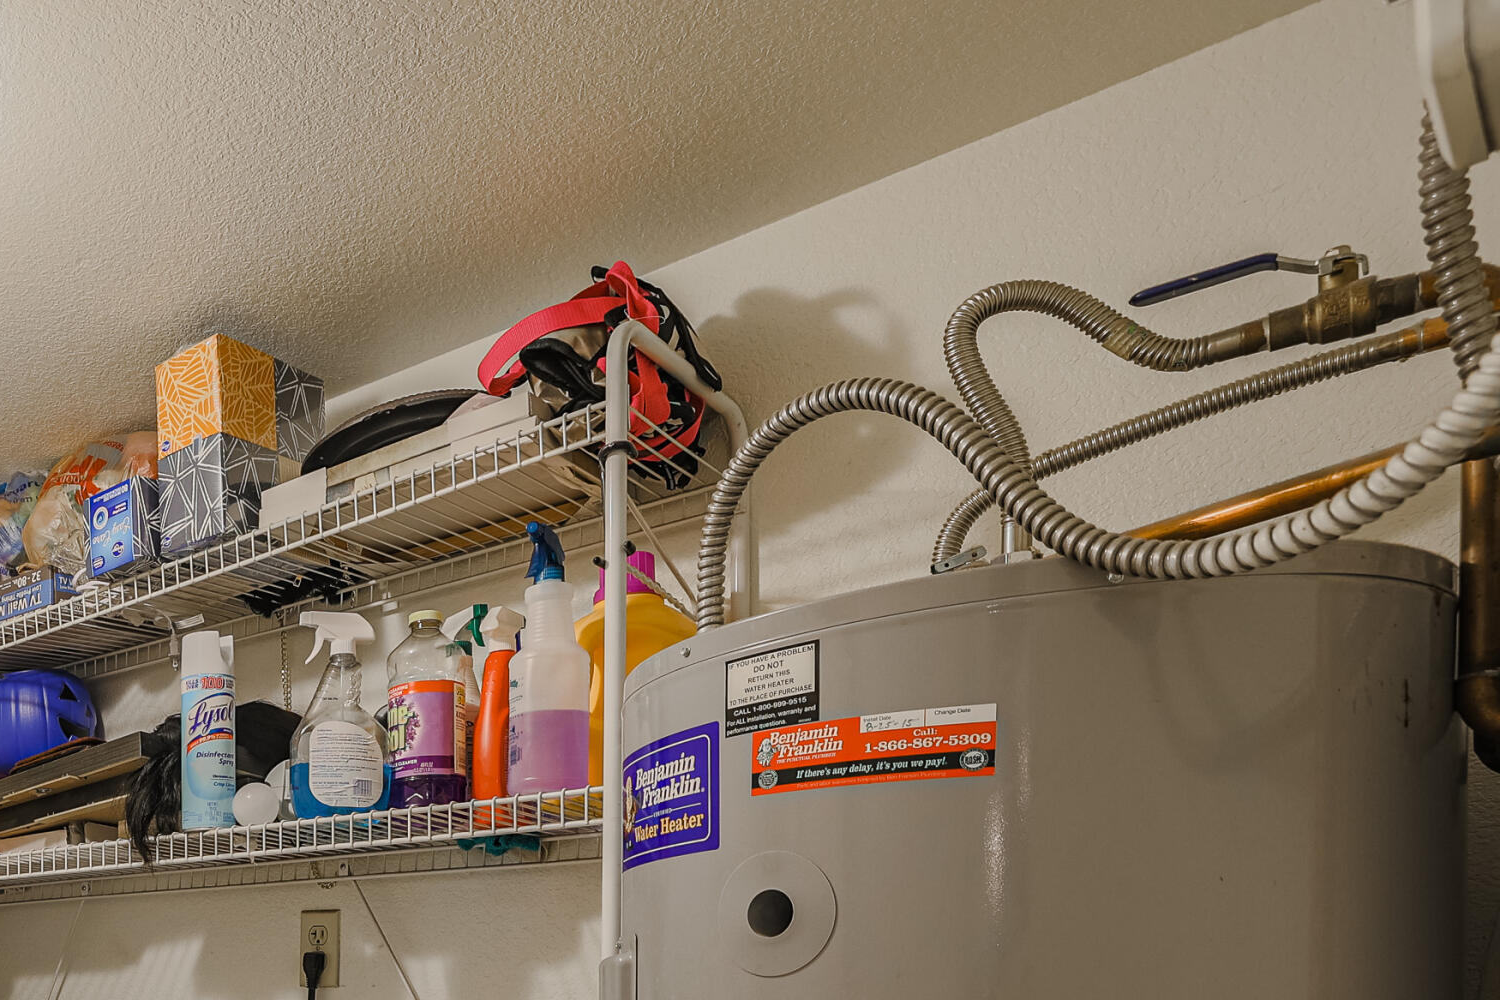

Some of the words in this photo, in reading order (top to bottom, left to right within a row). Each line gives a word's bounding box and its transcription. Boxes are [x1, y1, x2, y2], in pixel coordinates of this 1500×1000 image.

[8, 599, 28, 613] Wall
[30, 593, 42, 607] TV
[751, 656, 769, 664] HAVE
[777, 645, 814, 657] PROBLEM
[754, 665, 765, 673] DO
[767, 660, 784, 669] NOT
[745, 684, 766, 693] WATER
[768, 678, 794, 688] HEATER
[748, 673, 774, 683] RETURN
[750, 693, 768, 702] PLACE
[779, 684, 812, 696] PURCHASE
[188, 700, 234, 736] Lysol
[934, 708, 956, 716] Change
[770, 724, 838, 745] Benjamin
[913, 728, 938, 737] Call:
[778, 738, 843, 758] Franklin
[864, 733, 992, 753] 1-866-867-5309
[196, 752, 234, 760] Disinfectan
[635, 752, 696, 790] Benjamin
[796, 770, 804, 779] If
[805, 767, 832, 777] there's
[832, 766, 848, 775] any
[849, 763, 874, 774] delay,
[876, 761, 890, 770] it's
[892, 760, 908, 771] you
[911, 760, 923, 768] we
[635, 824, 658, 842] Water
[660, 813, 704, 835] Heater
